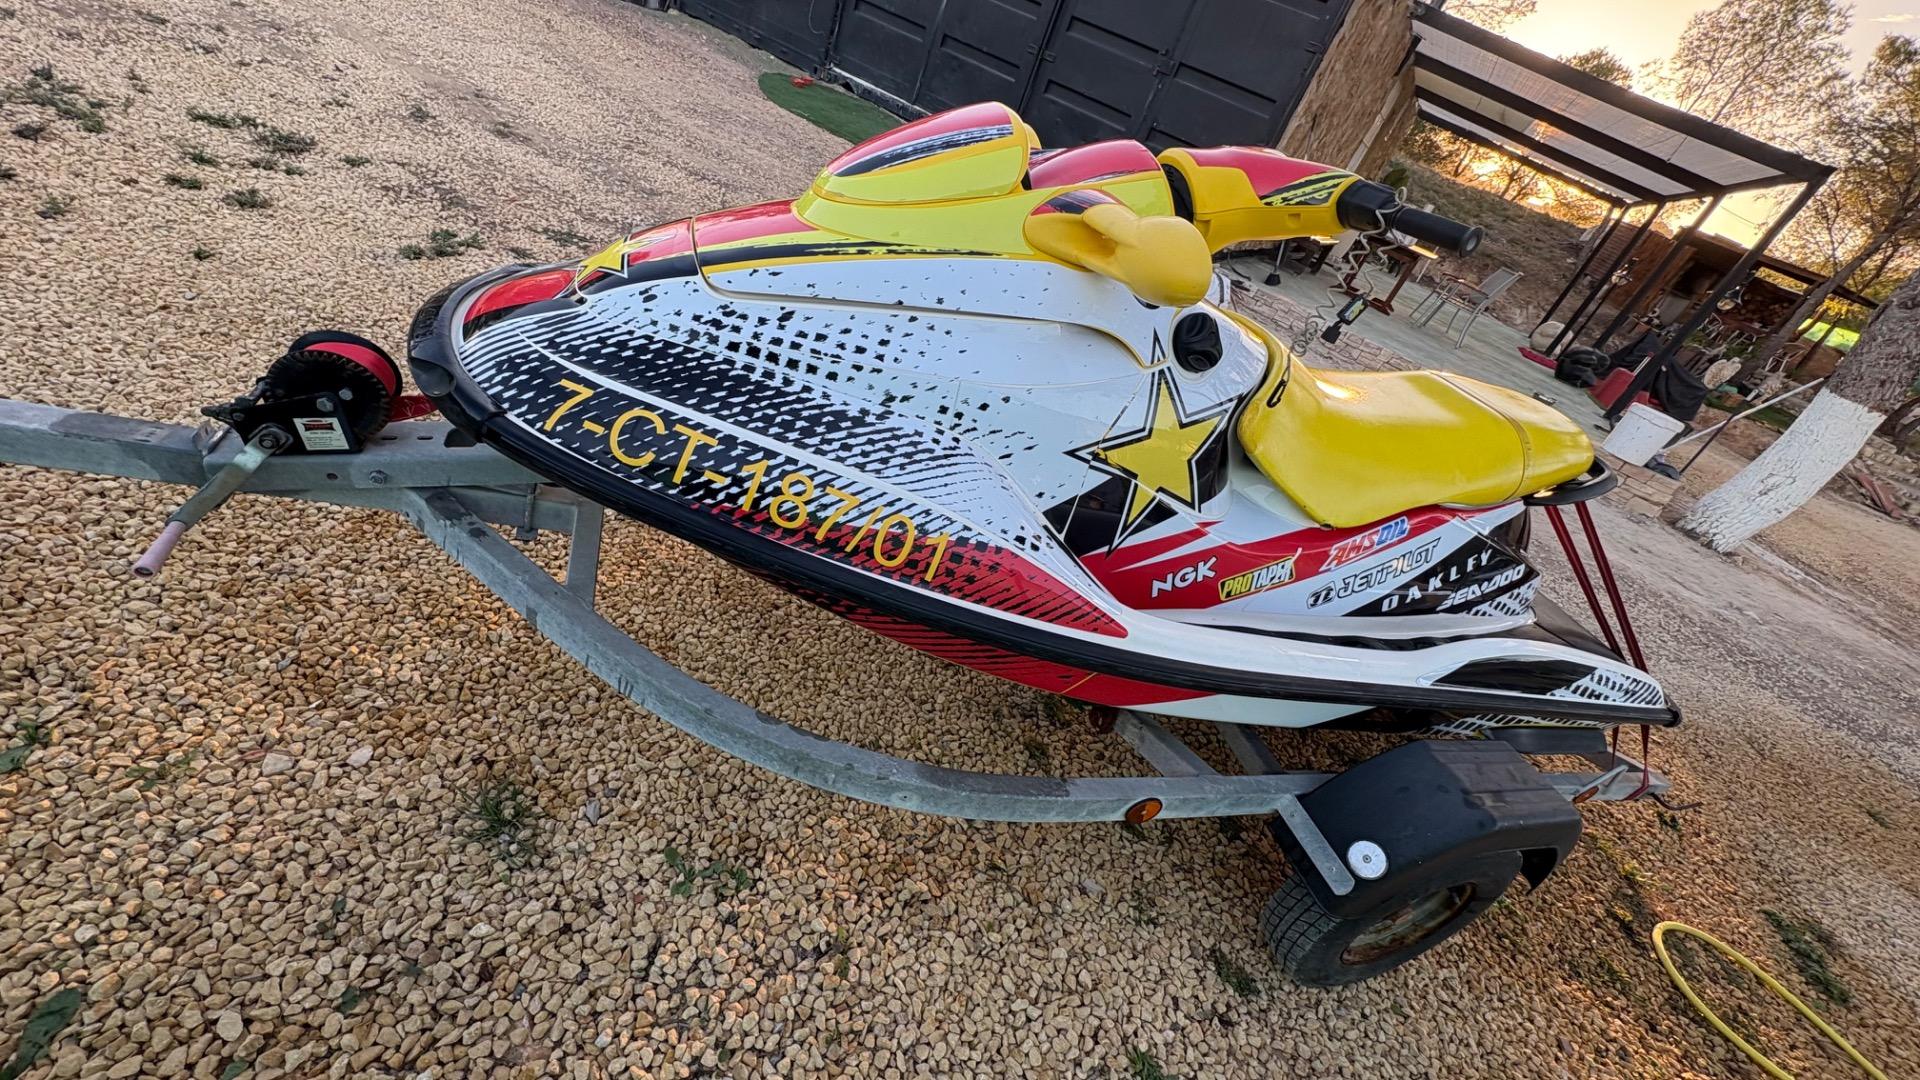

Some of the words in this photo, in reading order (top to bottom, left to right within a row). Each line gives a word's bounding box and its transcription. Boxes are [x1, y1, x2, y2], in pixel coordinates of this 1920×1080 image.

[543, 379, 951, 582] 7-CT-187/01
[1319, 517, 1408, 571] AMSOIL
[1337, 537, 1441, 598] JETPILOT
[1151, 556, 1218, 598] NGK
[1222, 558, 1294, 599] PROTAPER
